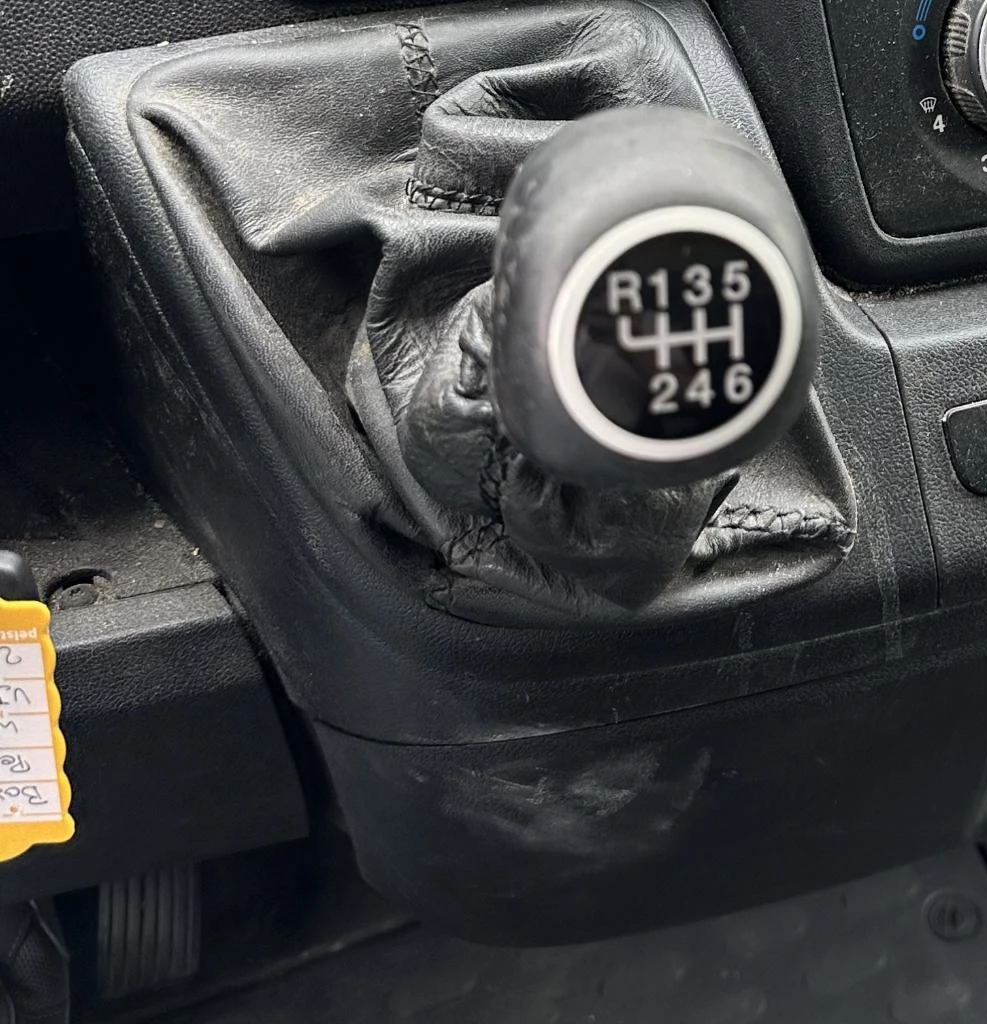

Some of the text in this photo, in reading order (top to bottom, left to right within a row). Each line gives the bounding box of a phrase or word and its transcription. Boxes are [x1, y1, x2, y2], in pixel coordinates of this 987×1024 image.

[931, 114, 946, 134] 4
[606, 259, 751, 315] R 1 3 5
[649, 362, 754, 415] 2 4 6
